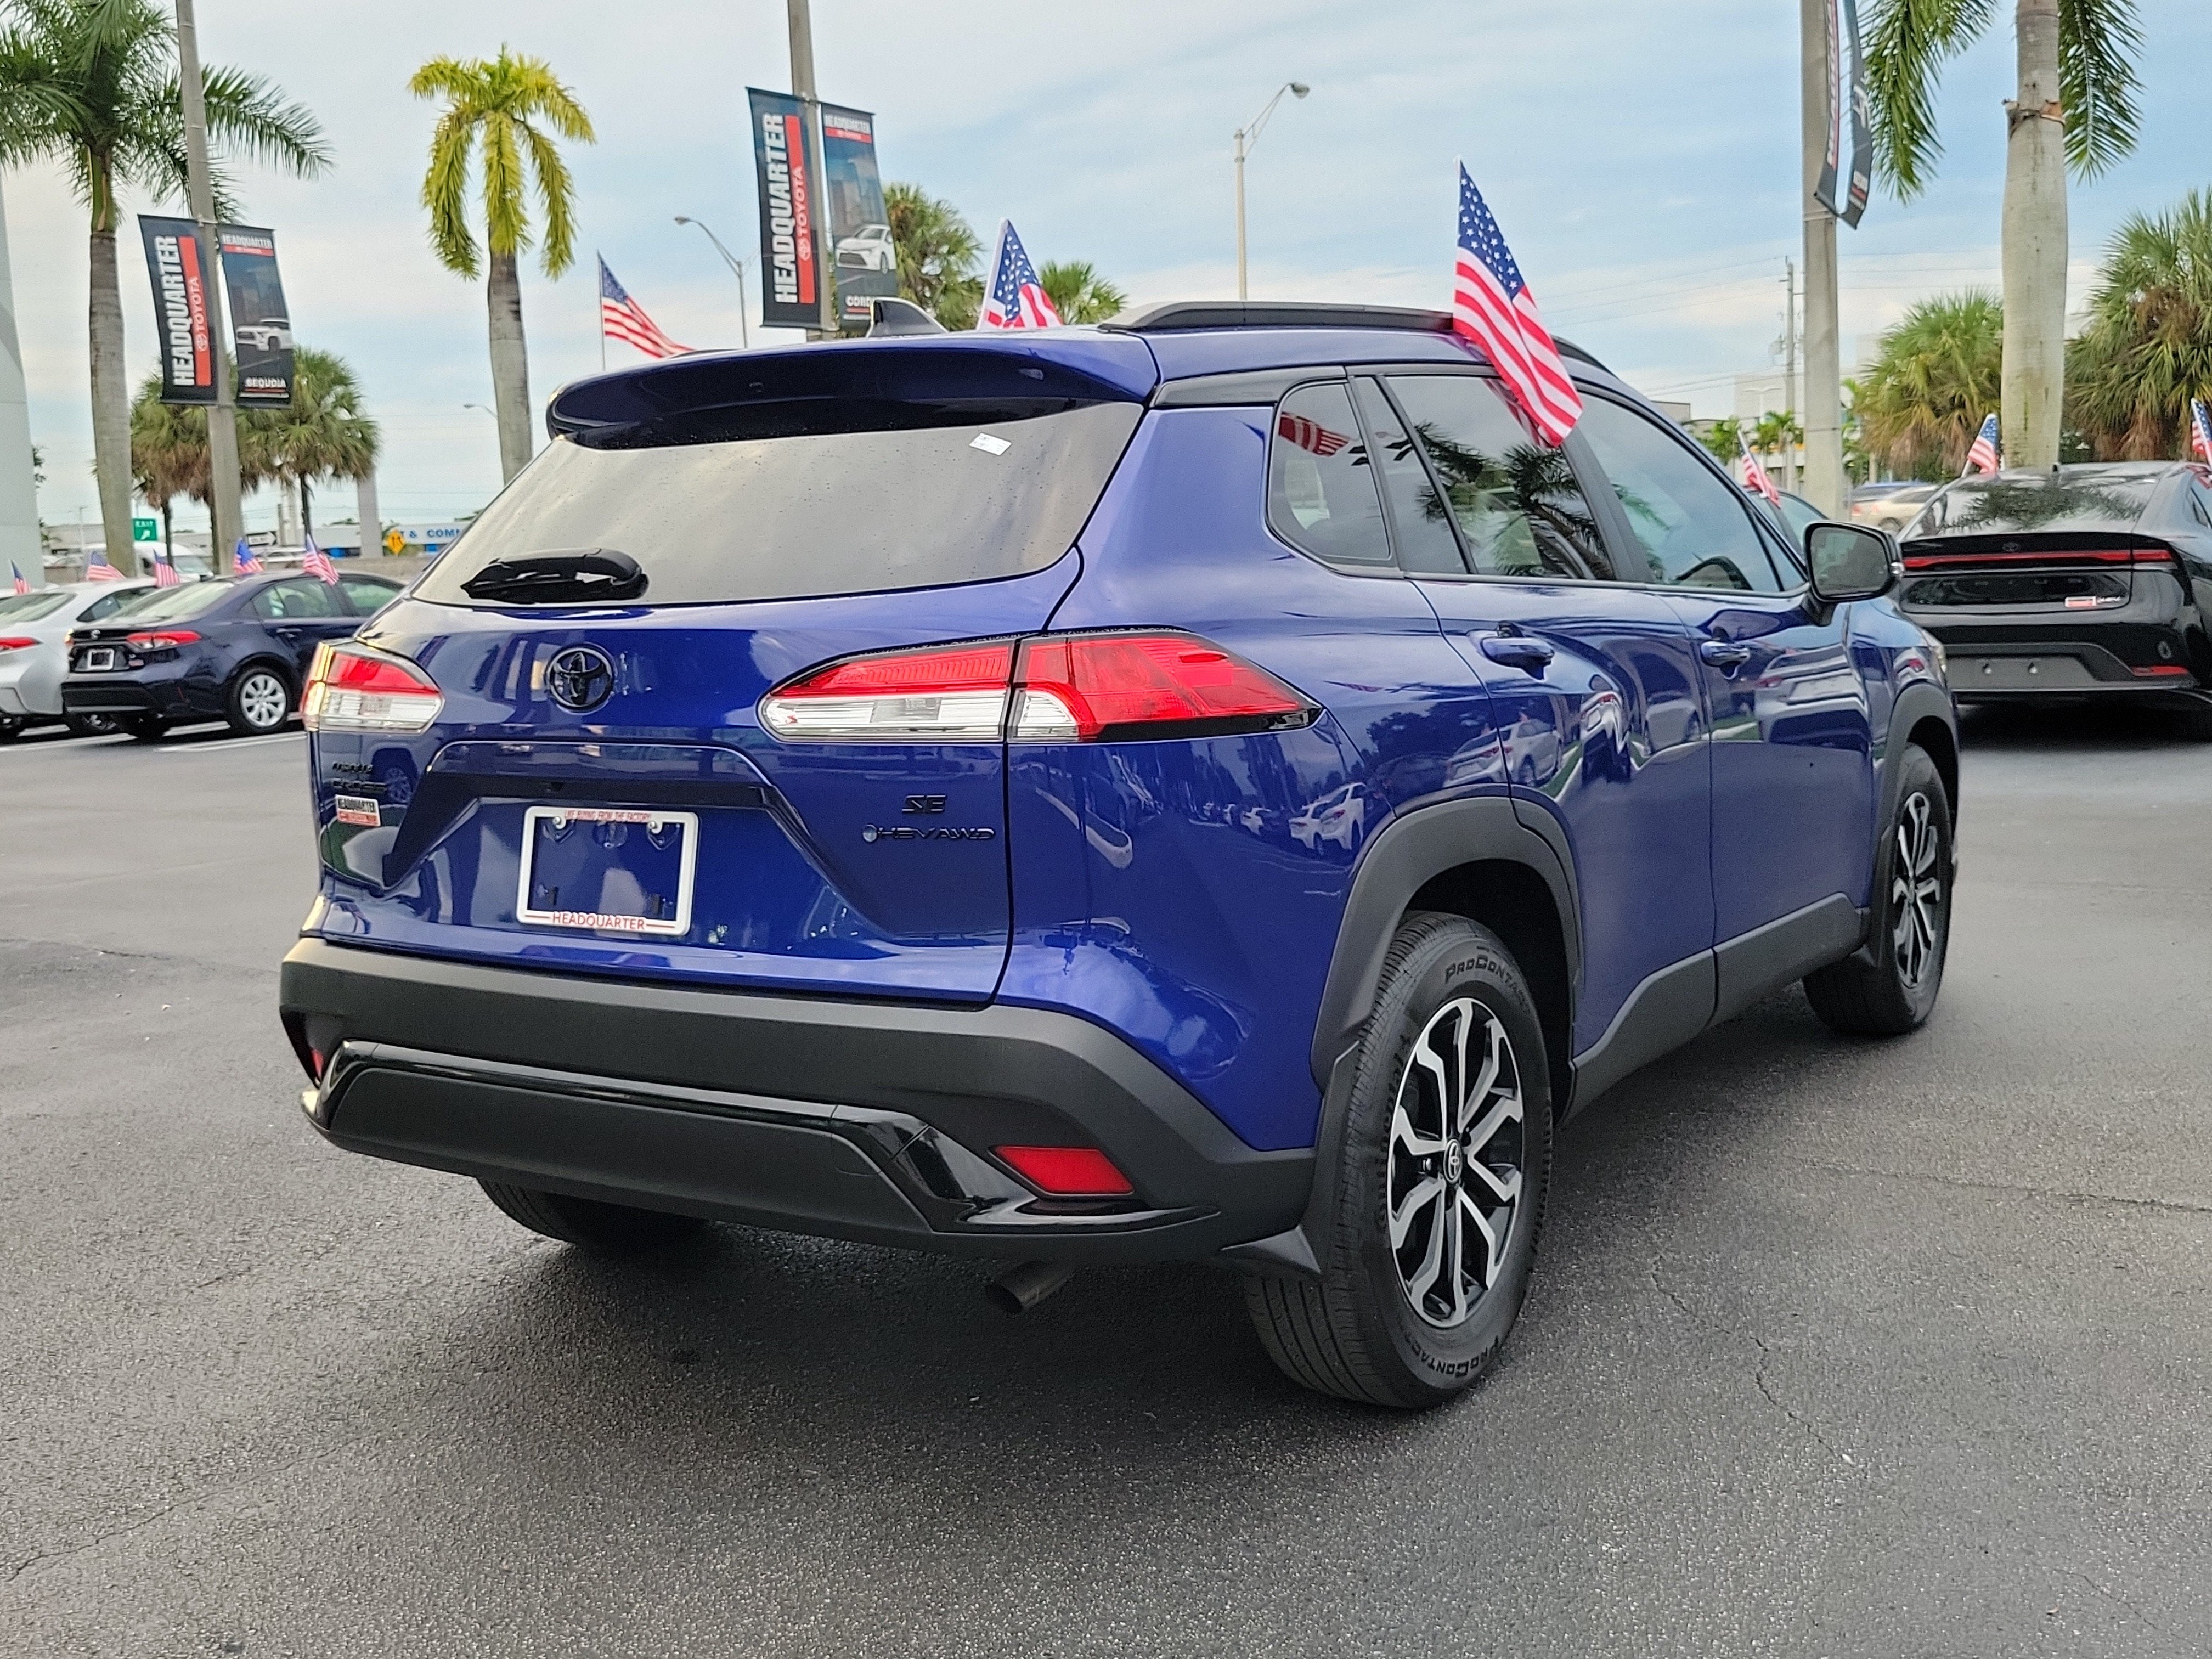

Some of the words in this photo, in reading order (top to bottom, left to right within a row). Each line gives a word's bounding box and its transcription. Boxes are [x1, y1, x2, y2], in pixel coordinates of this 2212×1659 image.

[763, 114, 798, 303] HEADQUARTER
[792, 166, 808, 237] TOYOTA
[155, 235, 195, 386] HEADQUARTER
[187, 276, 205, 332] TOYOTA
[245, 377, 286, 388] SEQUOIA
[901, 794, 948, 814] SE
